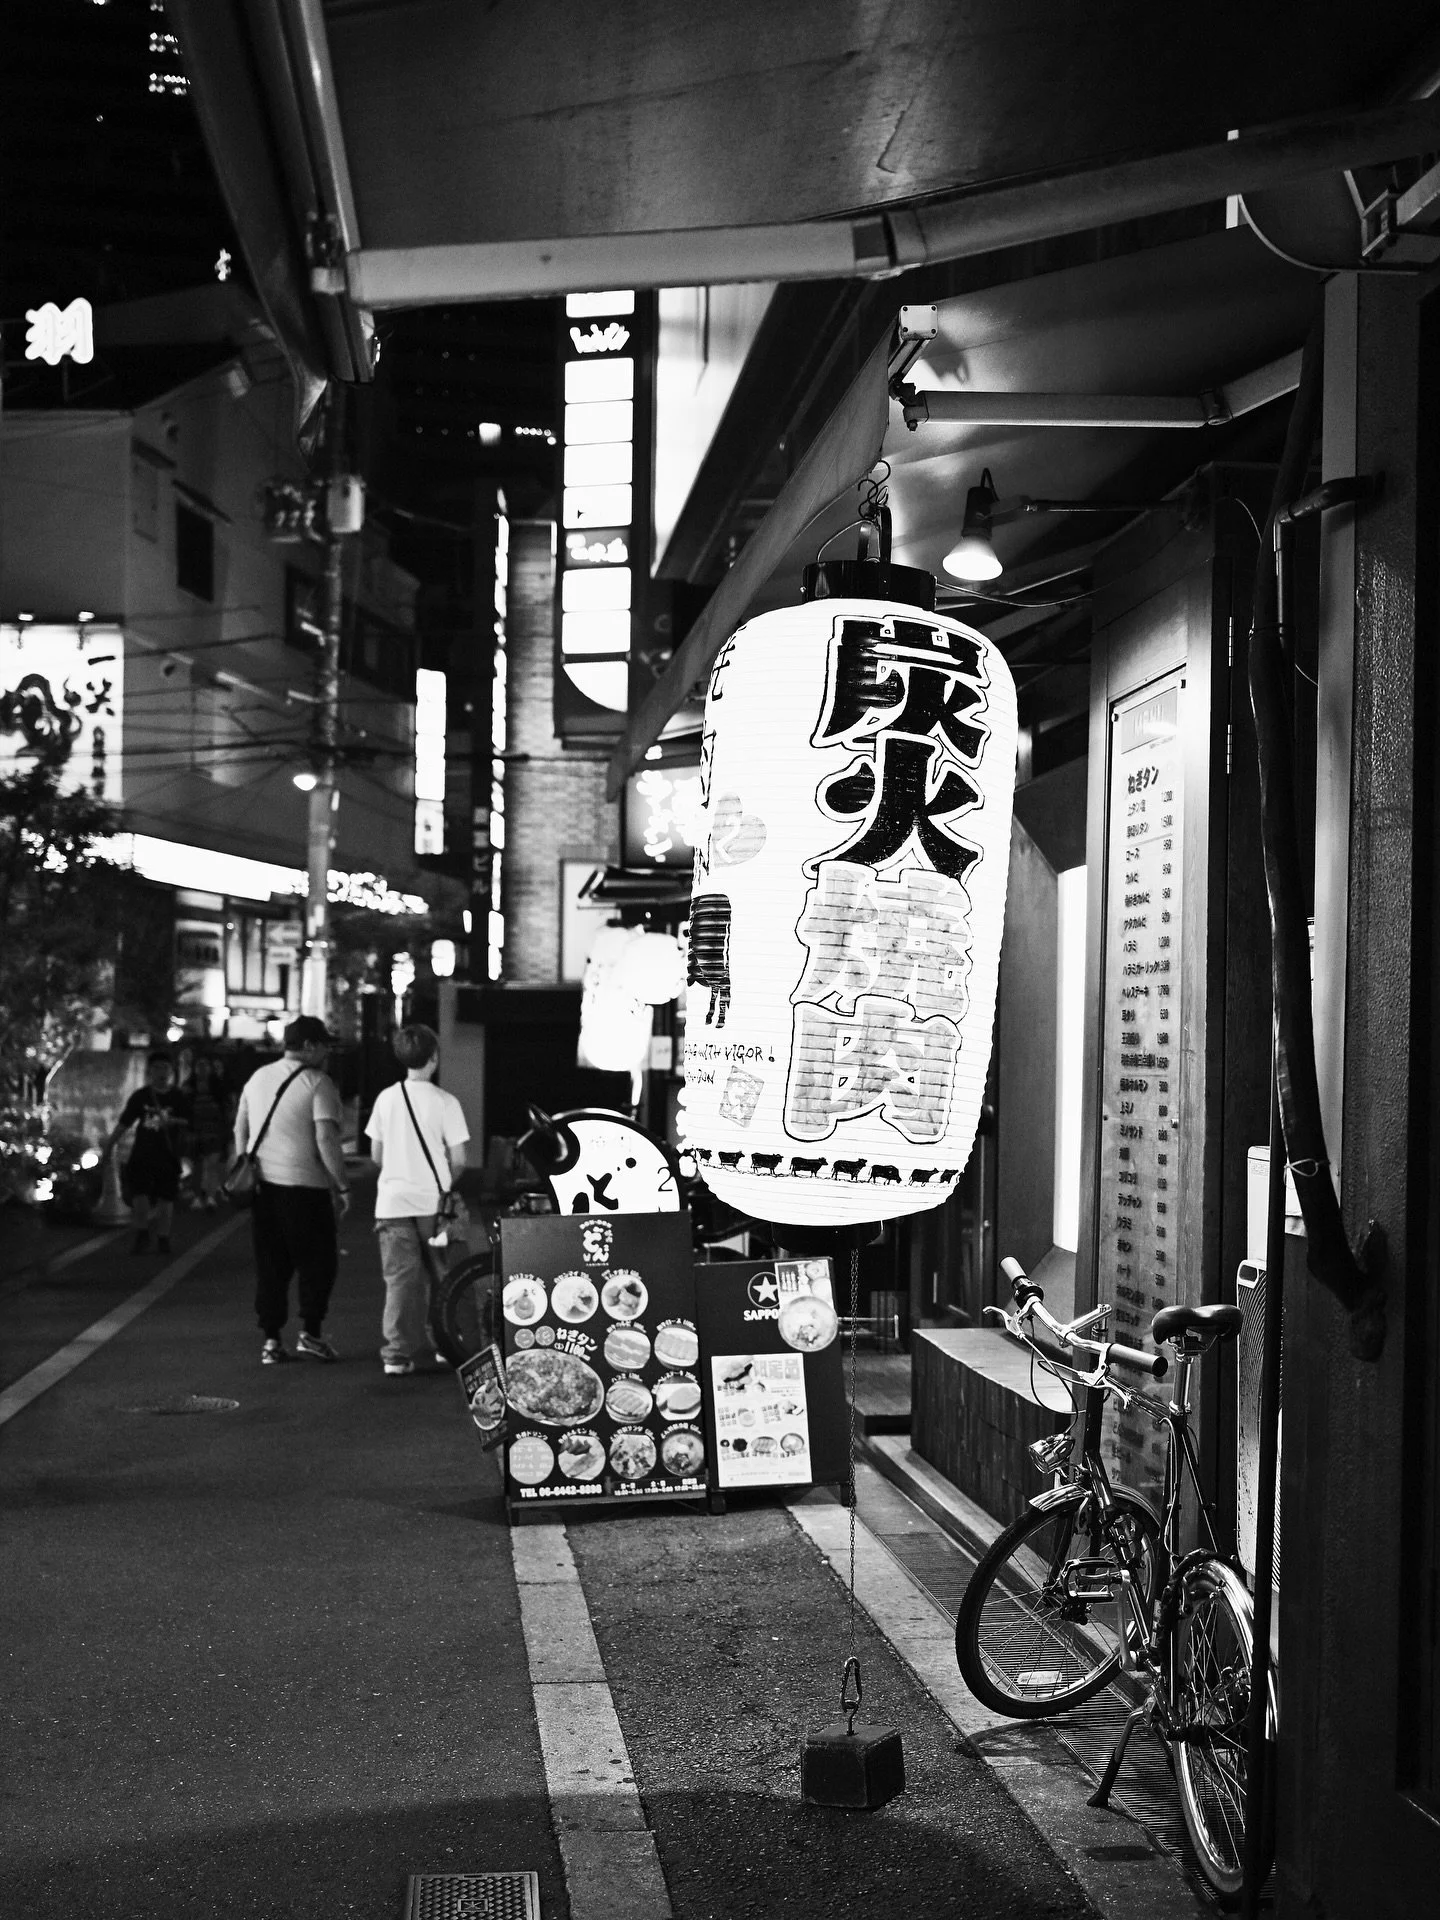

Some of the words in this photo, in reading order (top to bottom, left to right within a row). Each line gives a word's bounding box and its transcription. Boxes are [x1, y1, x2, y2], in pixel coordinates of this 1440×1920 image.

[1127, 766, 1159, 794] ねぎタン
[1126, 848, 1139, 860] ロース
[1123, 940, 1137, 952] ハラミ
[725, 1044, 764, 1064] VIGOR
[743, 1309, 780, 1321] SAPPO
[556, 1327, 598, 1351] ねぎタン
[520, 1487, 538, 1498] TEL
